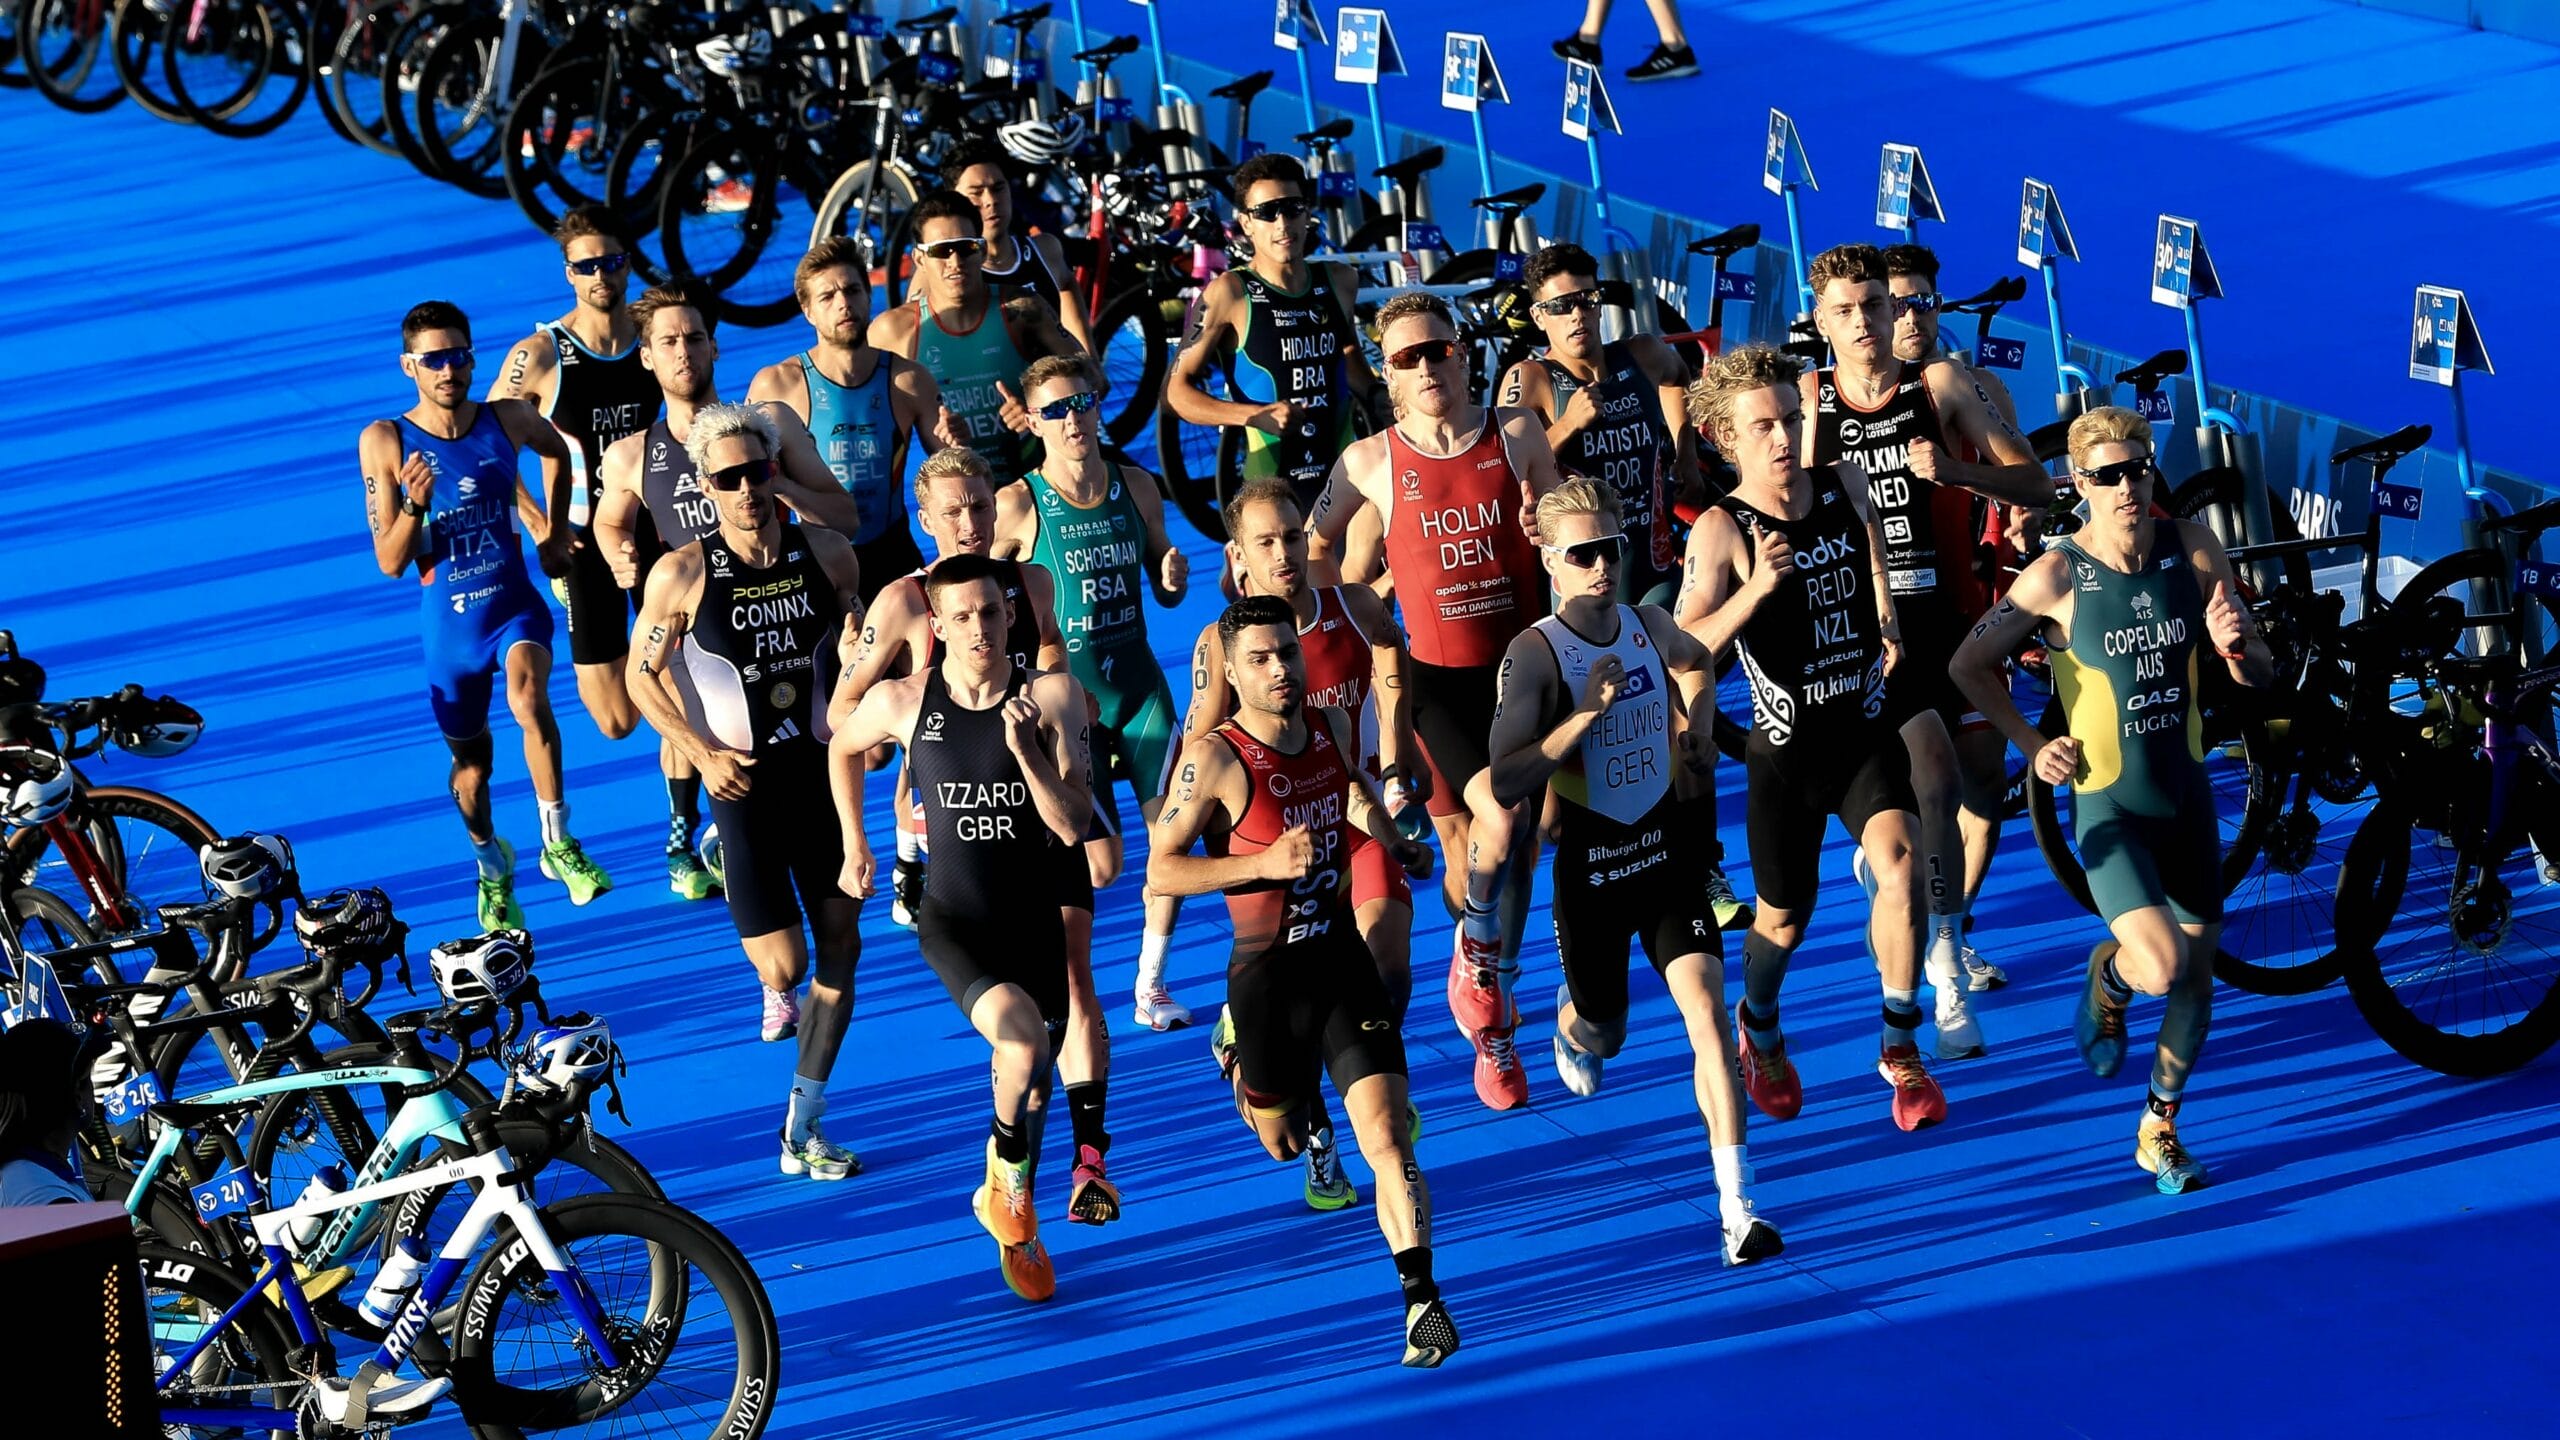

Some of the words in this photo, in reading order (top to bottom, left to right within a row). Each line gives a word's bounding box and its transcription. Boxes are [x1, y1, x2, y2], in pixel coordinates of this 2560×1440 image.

[1271, 309, 1307, 318] Triathlon
[1275, 318, 1298, 327] Brasil
[2417, 315, 2432, 348] 1/A
[1281, 332, 1336, 362] HIDALGO
[1292, 365, 1326, 391] BRA
[592, 403, 641, 431] PAYET
[1602, 392, 1640, 418] OGOS
[1865, 409, 1915, 431] NEDERLANDSE
[1583, 421, 1652, 458] BATISTA
[830, 462, 884, 484] BEL
[1605, 457, 1642, 489] POR
[1868, 476, 1909, 510] NED
[437, 500, 503, 535] SARZILLA
[1060, 519, 1111, 533] BAHRAIN
[1420, 499, 1501, 539] HOLM
[450, 529, 500, 562] ITA
[1061, 527, 1112, 540] VICTORIOUS
[1064, 541, 1137, 575] SCHOEMAN
[1440, 535, 1495, 571] DEN
[448, 559, 505, 582] dorelan
[468, 584, 504, 601] THEMA
[733, 574, 803, 600] POISSY
[1081, 573, 1127, 605] RSA
[1435, 583, 1468, 598] apollo
[1479, 575, 1511, 589] sports
[1806, 566, 1856, 610] REID
[732, 592, 815, 631] CONINX
[1067, 605, 1137, 633] HUUB
[1440, 602, 1467, 617] TEAM
[1468, 595, 1514, 613] DANMARK
[2136, 609, 2153, 620] AIS
[649, 626, 665, 644] 5
[755, 627, 798, 658] FRA
[864, 627, 875, 645] 3
[1815, 611, 1859, 649] NZL
[2104, 618, 2186, 657] COPELAND
[770, 656, 811, 673] SFERIS
[1817, 649, 1863, 669] SUZUKI
[2136, 651, 2164, 682] AUS
[1803, 669, 1861, 705] TQ.kiwi
[2126, 687, 2180, 711] QAS
[1588, 701, 1664, 751] HELLWIG
[2124, 711, 2182, 738] FUGEN
[1181, 763, 1197, 784] 6
[1605, 746, 1658, 789] GER
[937, 782, 1025, 809] IZZARD
[1283, 792, 1341, 834] SANCHEZ
[957, 816, 1016, 841] GBR
[1588, 840, 1639, 864] Bitburger
[1608, 850, 1667, 881] SUZUKI
[1287, 919, 1331, 944] BH
[128, 1082, 156, 1106] 2/C
[1403, 1161, 1418, 1183] 6
[499, 1237, 530, 1276] DT
[466, 1271, 501, 1340] SWISS
[384, 1287, 437, 1362] ROSE
